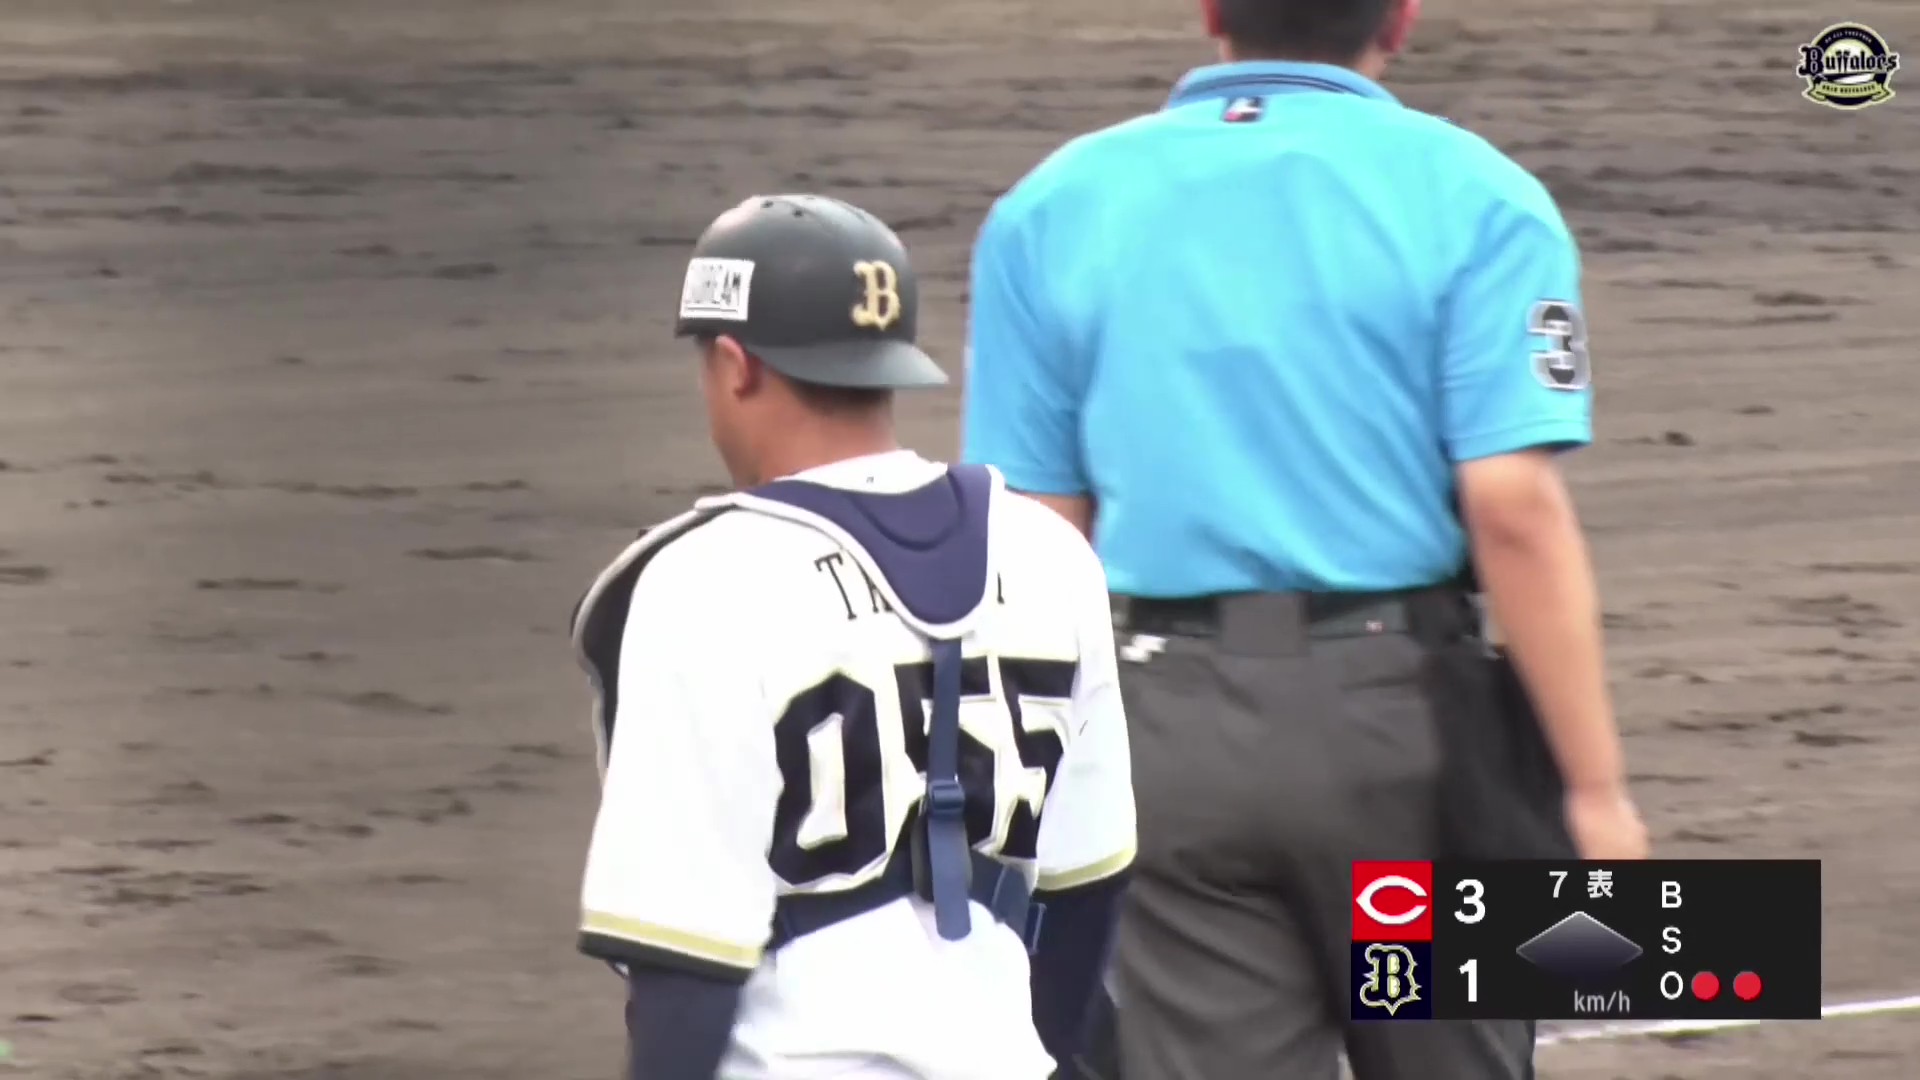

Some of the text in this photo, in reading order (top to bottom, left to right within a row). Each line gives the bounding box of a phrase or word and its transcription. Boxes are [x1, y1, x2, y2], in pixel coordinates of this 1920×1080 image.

[852, 260, 901, 331] B
[1526, 299, 1592, 391] 3
[768, 655, 1079, 886] 055
